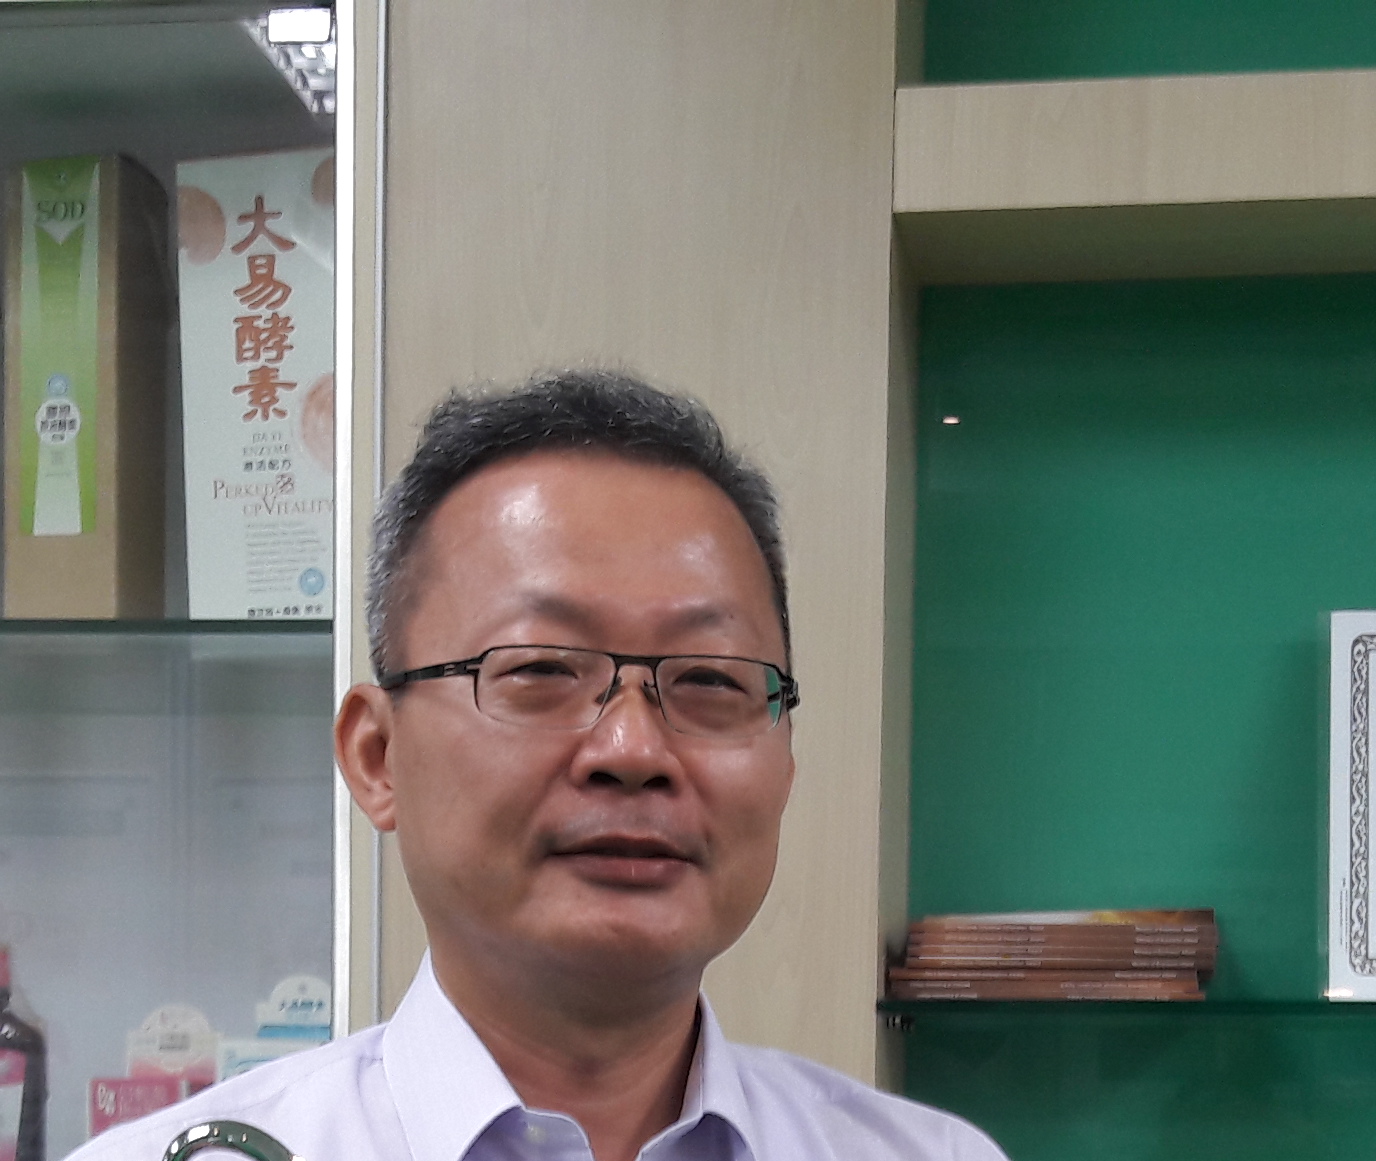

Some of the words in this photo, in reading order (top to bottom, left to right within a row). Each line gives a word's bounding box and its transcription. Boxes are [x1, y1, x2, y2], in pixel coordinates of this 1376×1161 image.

[37, 199, 86, 221] SOD
[230, 194, 298, 422] 大易酵素
